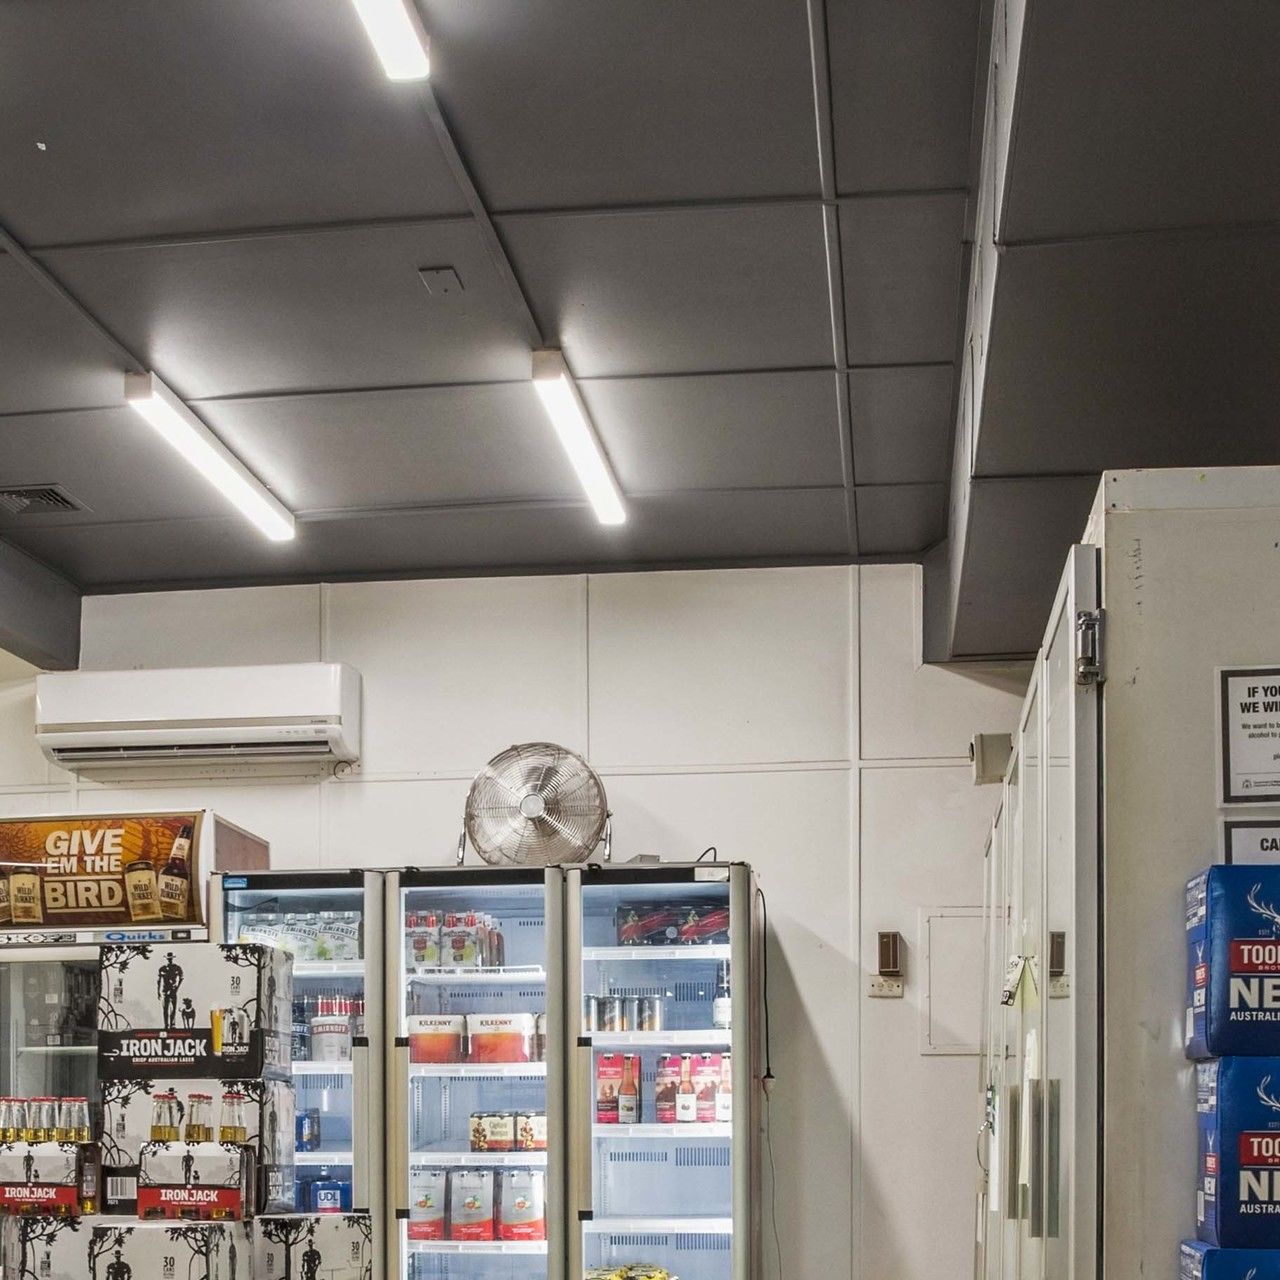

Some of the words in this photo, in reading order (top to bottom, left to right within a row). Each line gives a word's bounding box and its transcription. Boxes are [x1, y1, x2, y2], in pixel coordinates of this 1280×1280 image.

[1248, 687, 1259, 697] IF
[1240, 703, 1259, 713] WE
[45, 829, 125, 855] GIVE
[83, 856, 122, 872] THE
[45, 880, 123, 908] BIRD
[105, 932, 165, 942] Quirks
[231, 976, 241, 986] 30
[121, 1039, 164, 1056] IRON
[165, 1039, 206, 1056] JACK
[319, 1190, 339, 1202] UDL
